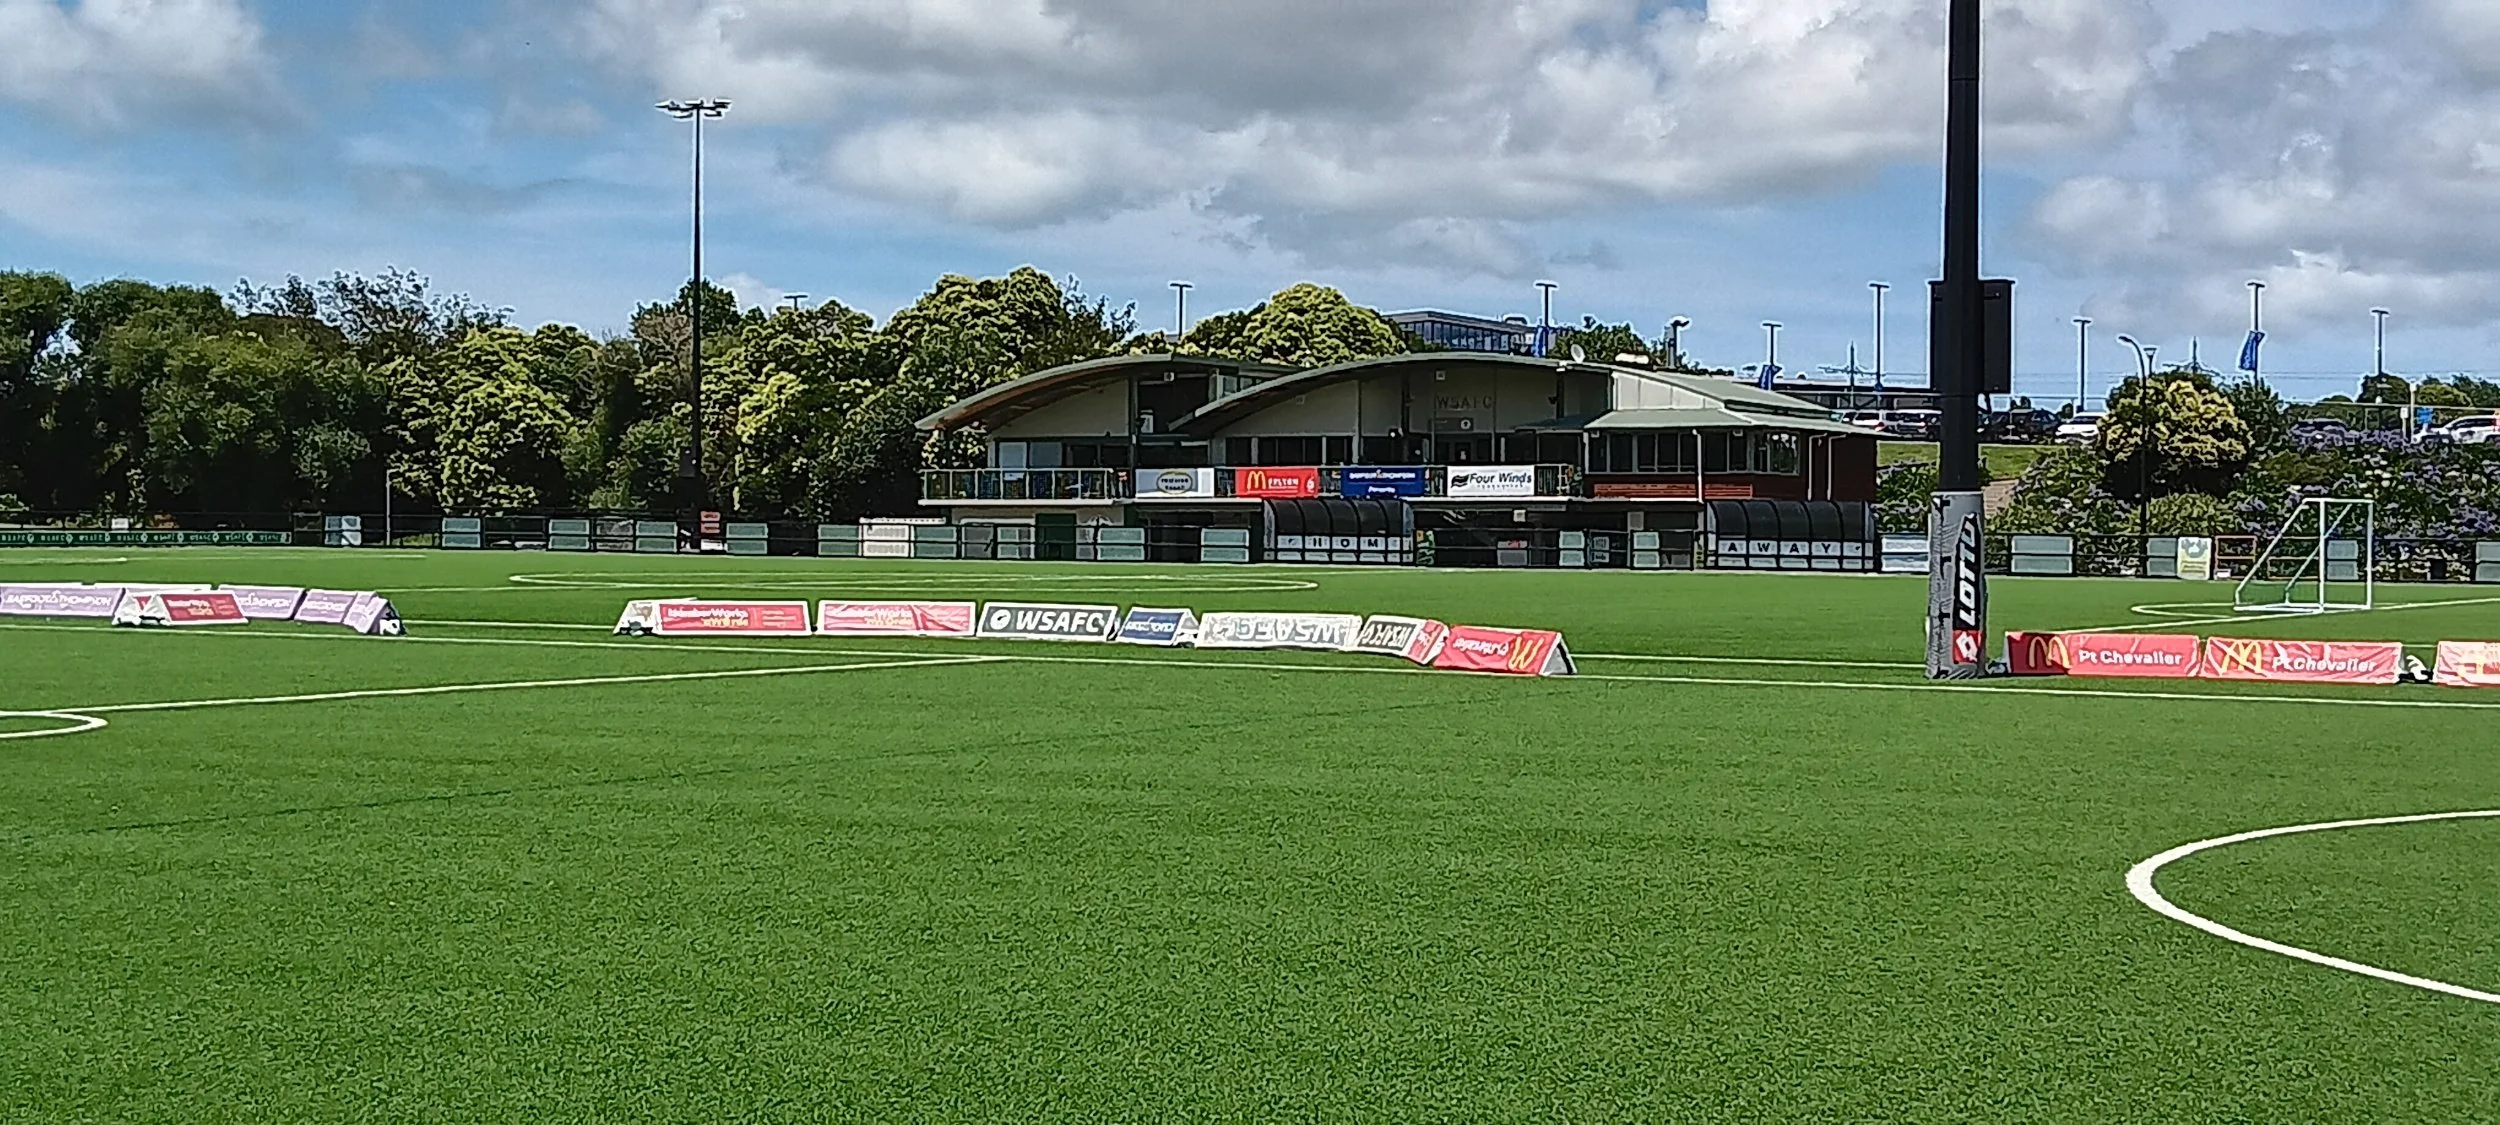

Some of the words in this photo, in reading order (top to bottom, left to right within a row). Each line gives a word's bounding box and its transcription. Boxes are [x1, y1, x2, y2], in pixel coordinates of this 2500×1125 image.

[1469, 472, 1494, 484] Four
[1498, 471, 1532, 486] Winds
[1727, 542, 1832, 554] AWAY
[1016, 609, 1102, 633] WSAFC
[2078, 649, 2098, 664] Pt
[2101, 650, 2184, 665] Chevalier
[2271, 656, 2292, 671] Pt
[2293, 656, 2377, 672] Chevalier
